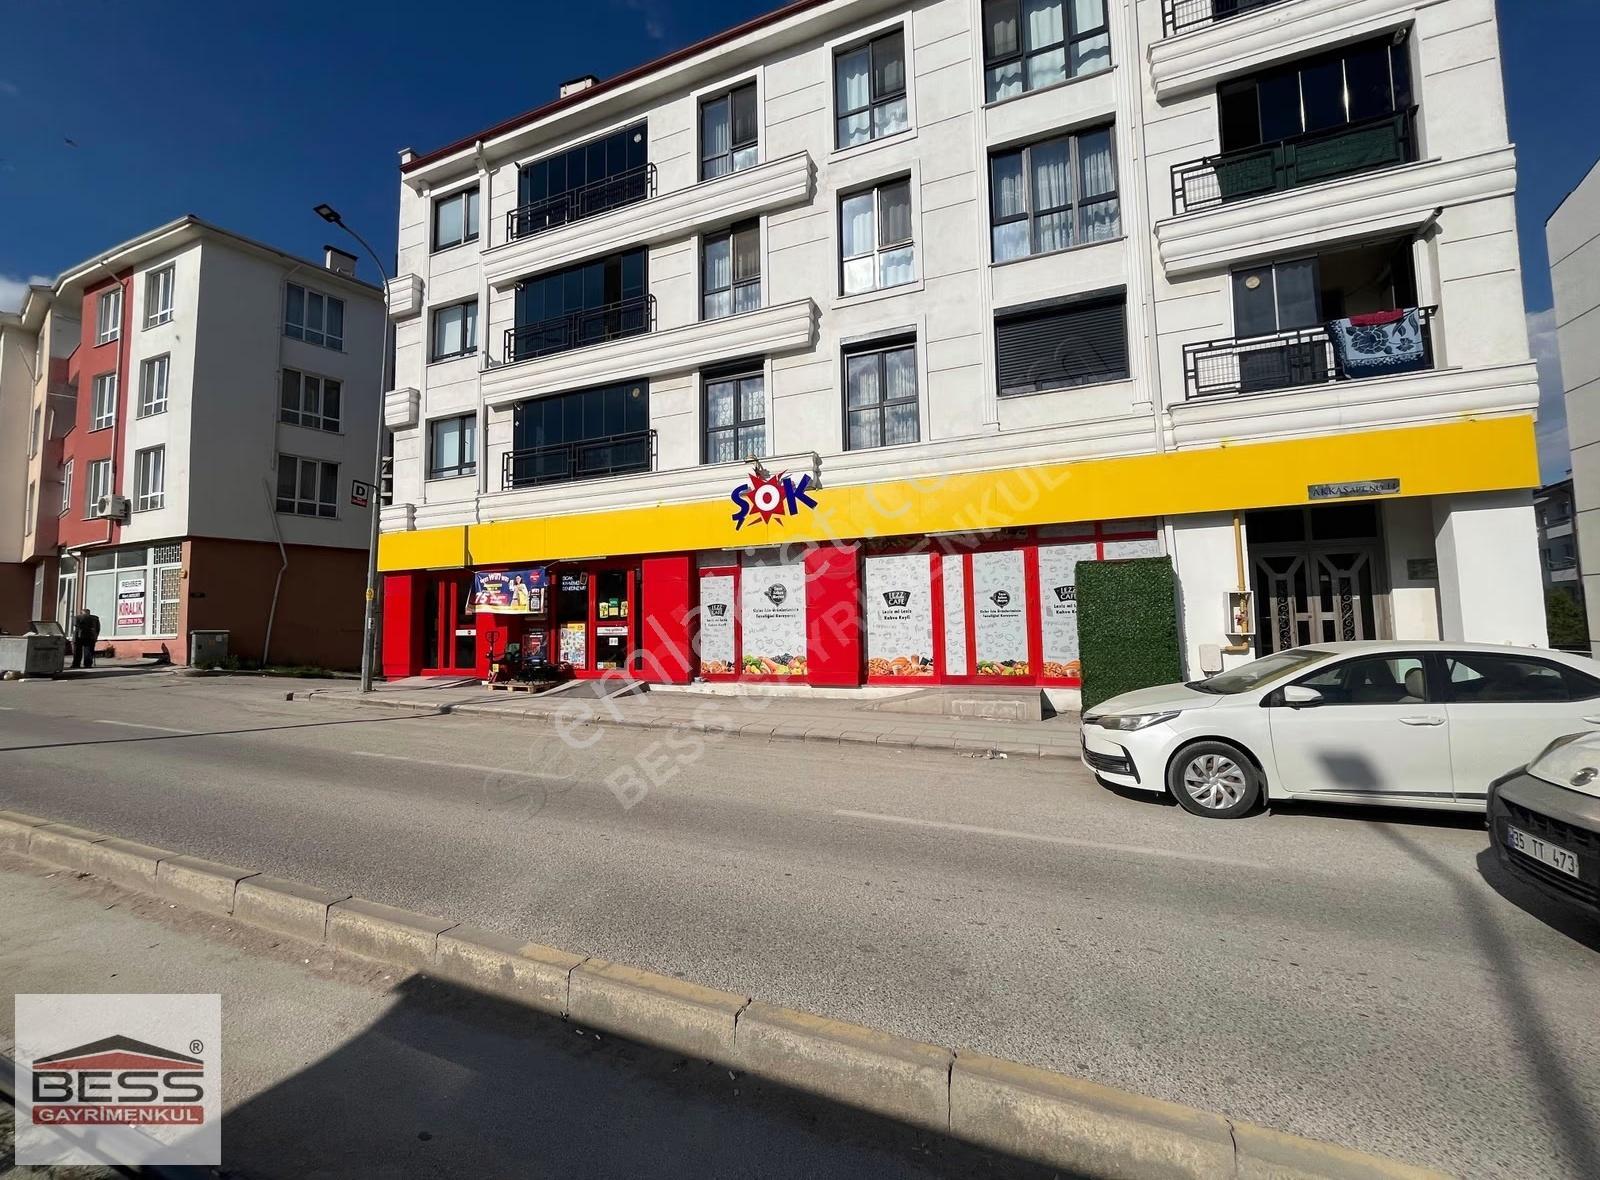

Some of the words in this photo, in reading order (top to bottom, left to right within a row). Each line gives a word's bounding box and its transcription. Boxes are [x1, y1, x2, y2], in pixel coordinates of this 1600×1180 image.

[356, 486, 366, 497] D
[730, 473, 818, 531] ŞOK
[1513, 831, 1525, 850] 35
[1532, 839, 1545, 860] TT
[1553, 848, 1575, 873] 473
